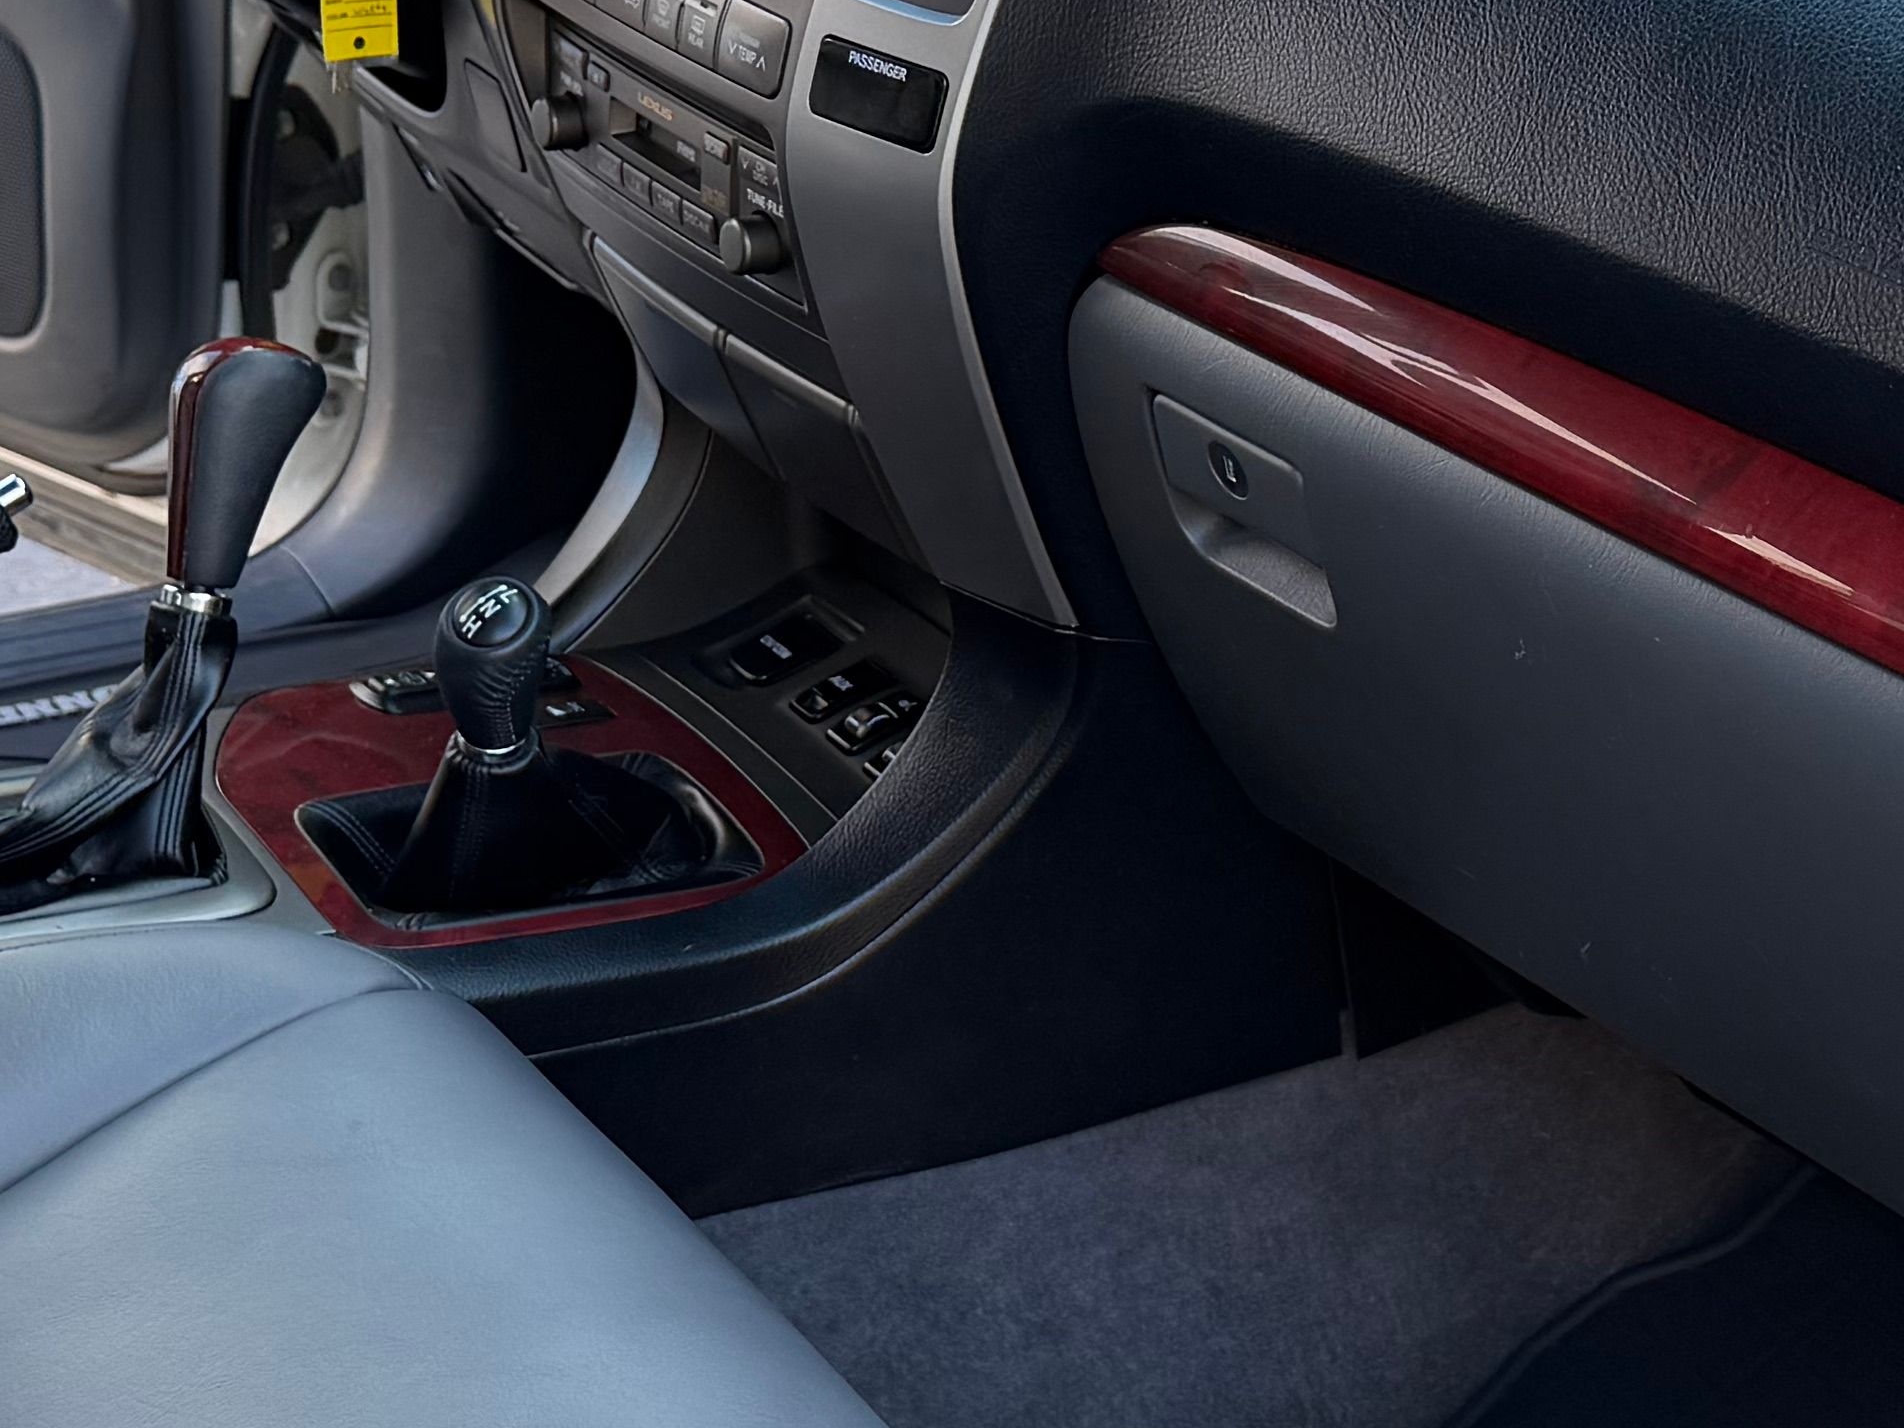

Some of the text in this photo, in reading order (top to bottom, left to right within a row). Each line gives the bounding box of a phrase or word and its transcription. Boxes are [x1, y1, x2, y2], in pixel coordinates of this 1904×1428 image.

[848, 50, 908, 82] PASSENGER
[461, 588, 519, 640] H N L
